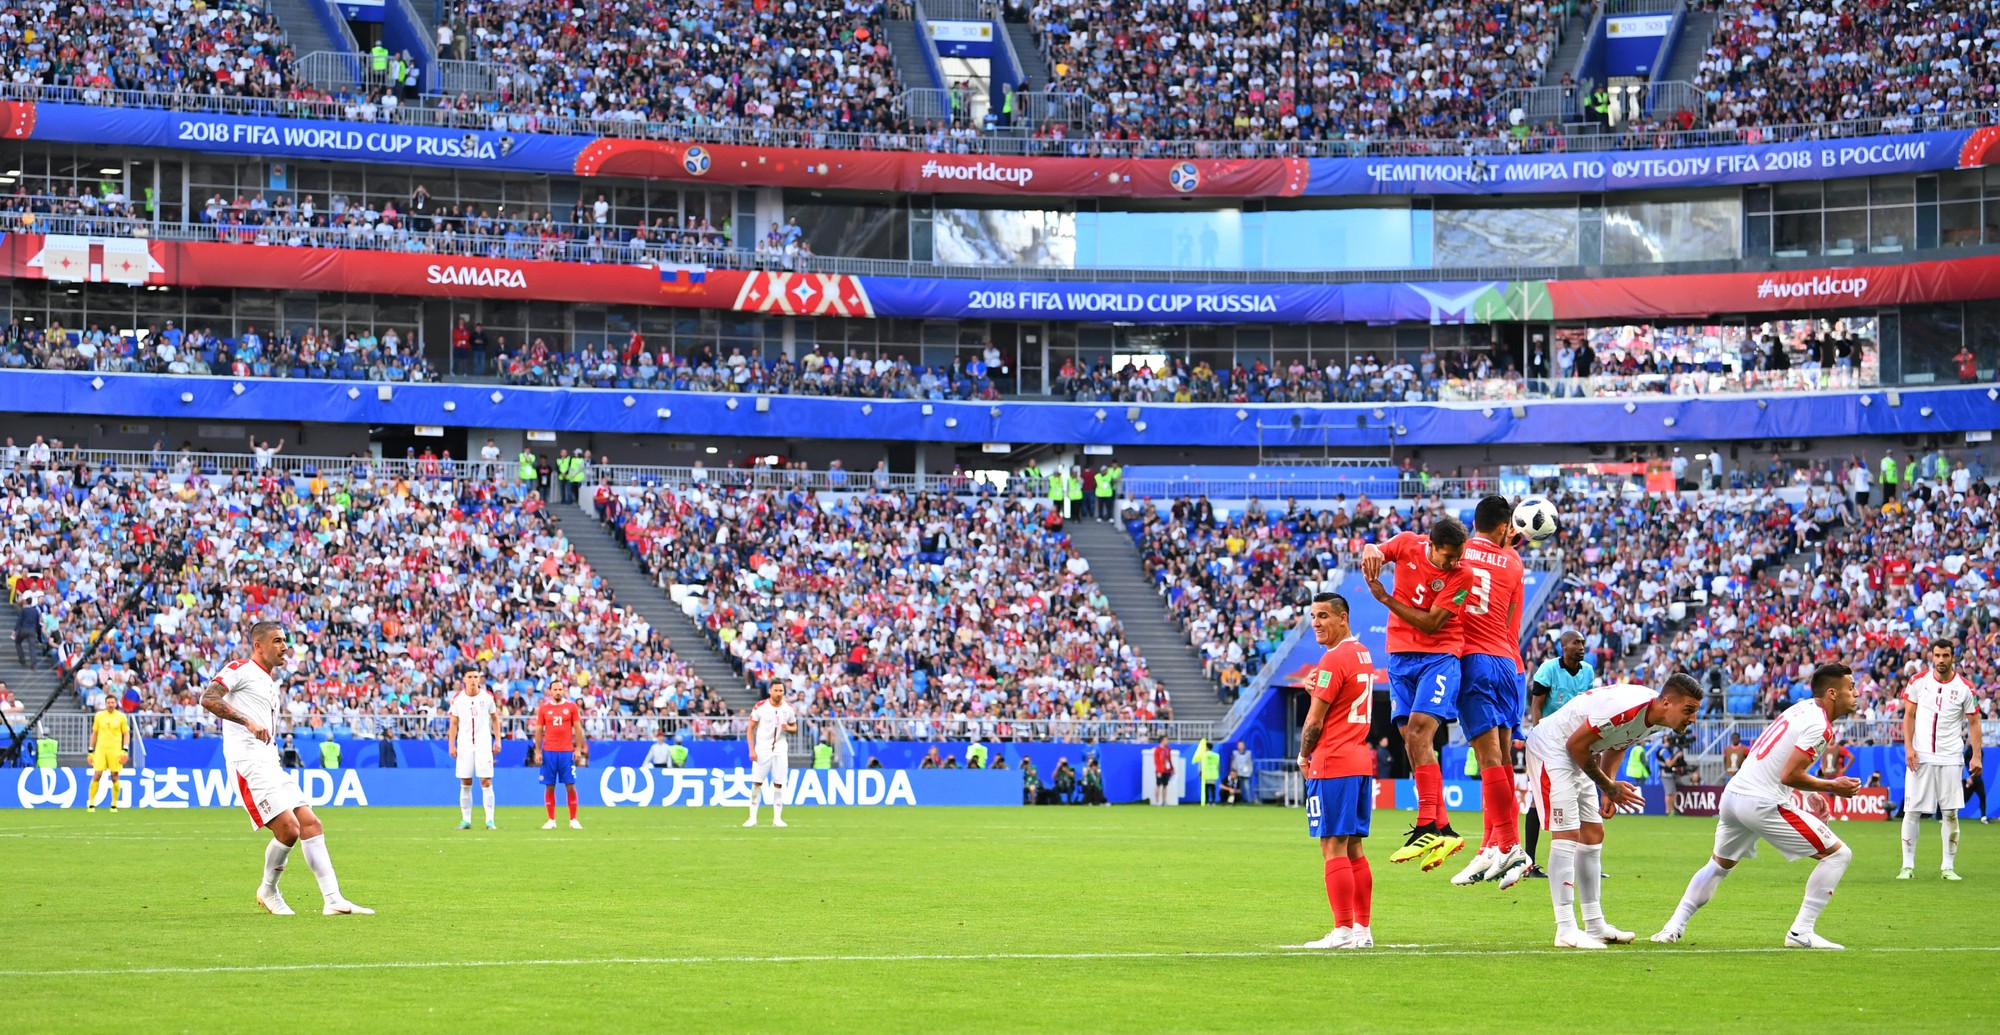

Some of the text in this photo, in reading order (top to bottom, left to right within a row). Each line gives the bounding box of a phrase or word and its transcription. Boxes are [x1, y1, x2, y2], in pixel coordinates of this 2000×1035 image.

[178, 121, 229, 142] 2018
[233, 124, 280, 146] FIFA
[283, 127, 363, 150] WORLD
[366, 132, 412, 153] CUP
[922, 160, 1033, 187] #worldcup
[1367, 141, 1925, 183] ЧЕМПИОНАТ МИРА ПО ФУТБОЛУ FIFA 2018 В РОССИИ
[427, 264, 527, 288] SAMARA
[1757, 275, 1867, 298] #worldcup
[968, 290, 1278, 313] 2018 FIFA WORLD CUP RUSSIA
[1465, 547, 1508, 569] GONZALEZ
[1411, 583, 1426, 605] 5
[1465, 567, 1492, 615] 3
[1434, 674, 1447, 697] 5
[1935, 696, 1943, 711] 4
[553, 716, 563, 726] 21
[86, 766, 368, 808] 万达 WDA
[661, 766, 917, 807] 万达 WANDA
[1673, 791, 1717, 813] QATAR
